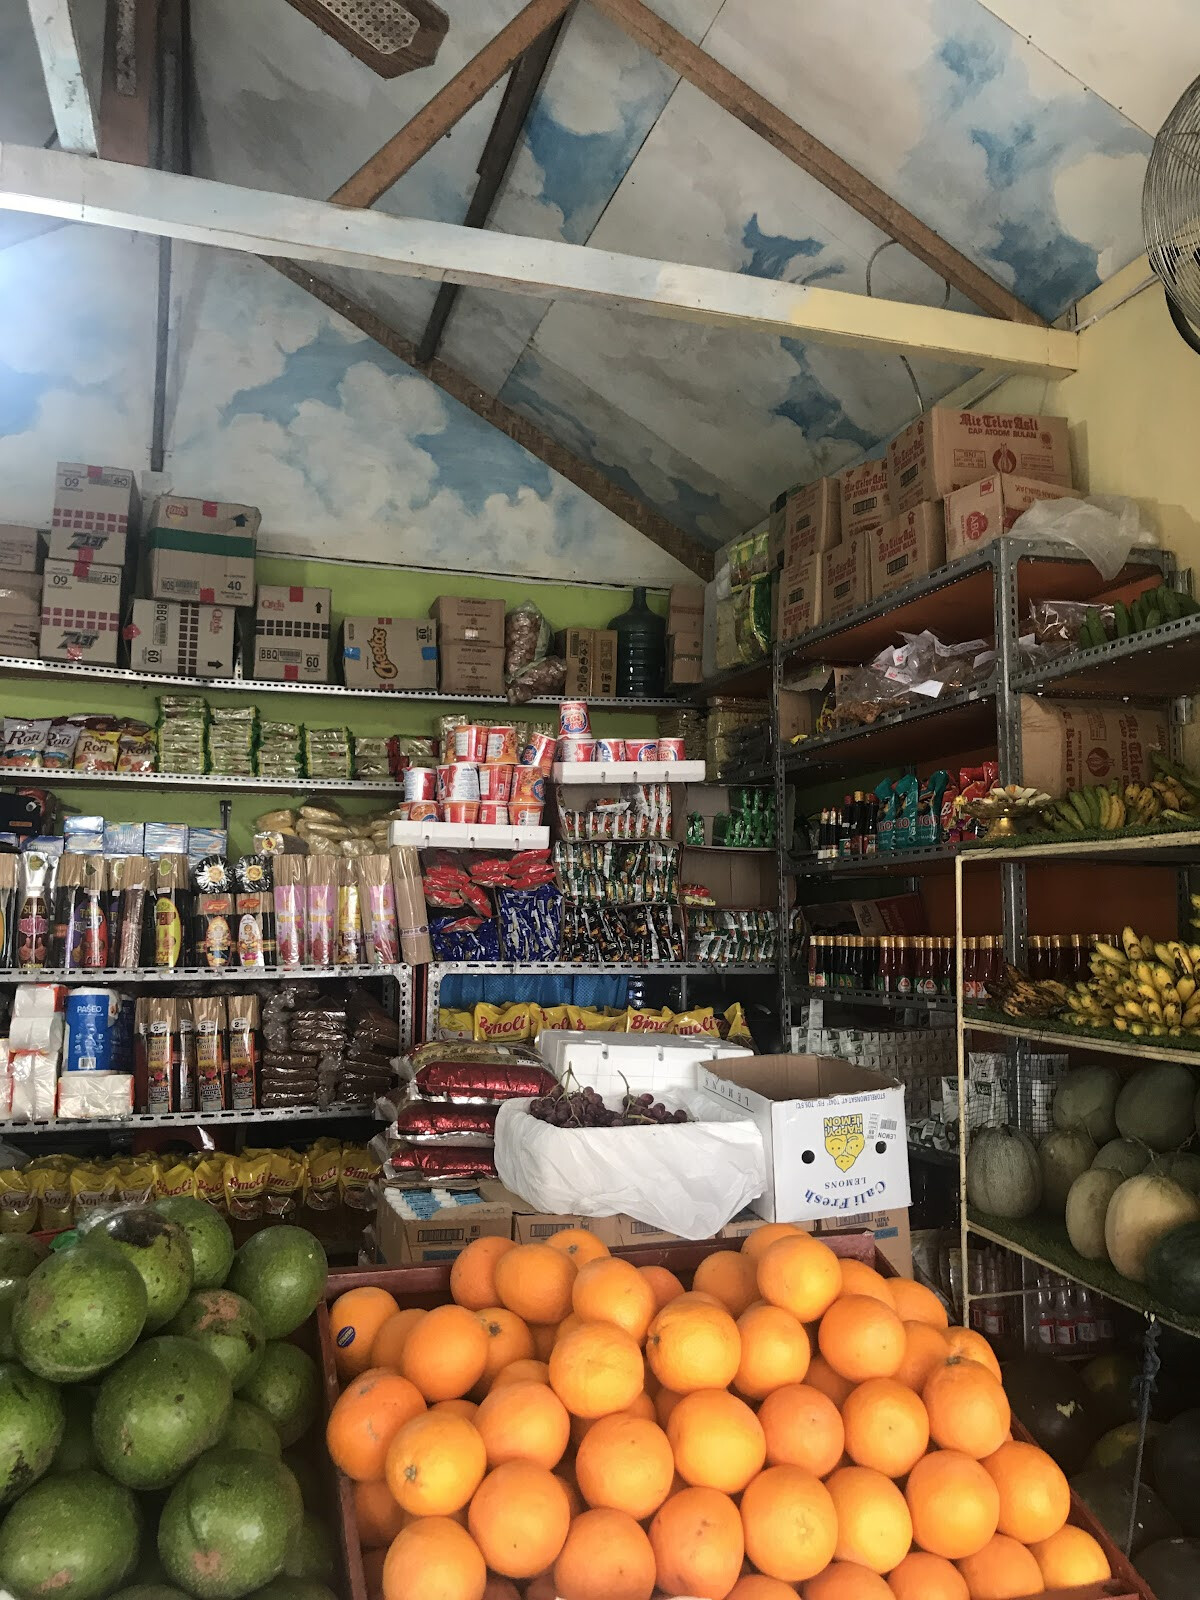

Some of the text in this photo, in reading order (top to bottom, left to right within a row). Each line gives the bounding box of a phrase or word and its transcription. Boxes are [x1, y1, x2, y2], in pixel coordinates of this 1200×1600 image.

[968, 427, 983, 435] CAP
[1013, 430, 1036, 439] BULAN
[64, 477, 79, 487] 60
[970, 515, 980, 539] ABC
[53, 575, 68, 585] 60
[101, 574, 118, 584] CHF
[227, 581, 242, 591] 40
[156, 603, 168, 621] BBQ
[418, 628, 427, 640] 60
[147, 650, 159, 663] 60
[260, 650, 278, 661] BBQ
[367, 627, 398, 679] Cheetos
[306, 656, 319, 668] 60
[8, 730, 41, 746] Roti
[24, 905, 46, 914] SUER
[76, 1004, 102, 1014] PASEO
[631, 1014, 669, 1031] Bimo
[704, 1077, 749, 1106] LEMONS
[823, 1113, 863, 1127] LEMON
[824, 1124, 863, 1137] HAPPY!
[877, 1131, 897, 1140] LEMON
[824, 1176, 867, 1190] LEMONS
[804, 1181, 886, 1210] Cali Fresh
